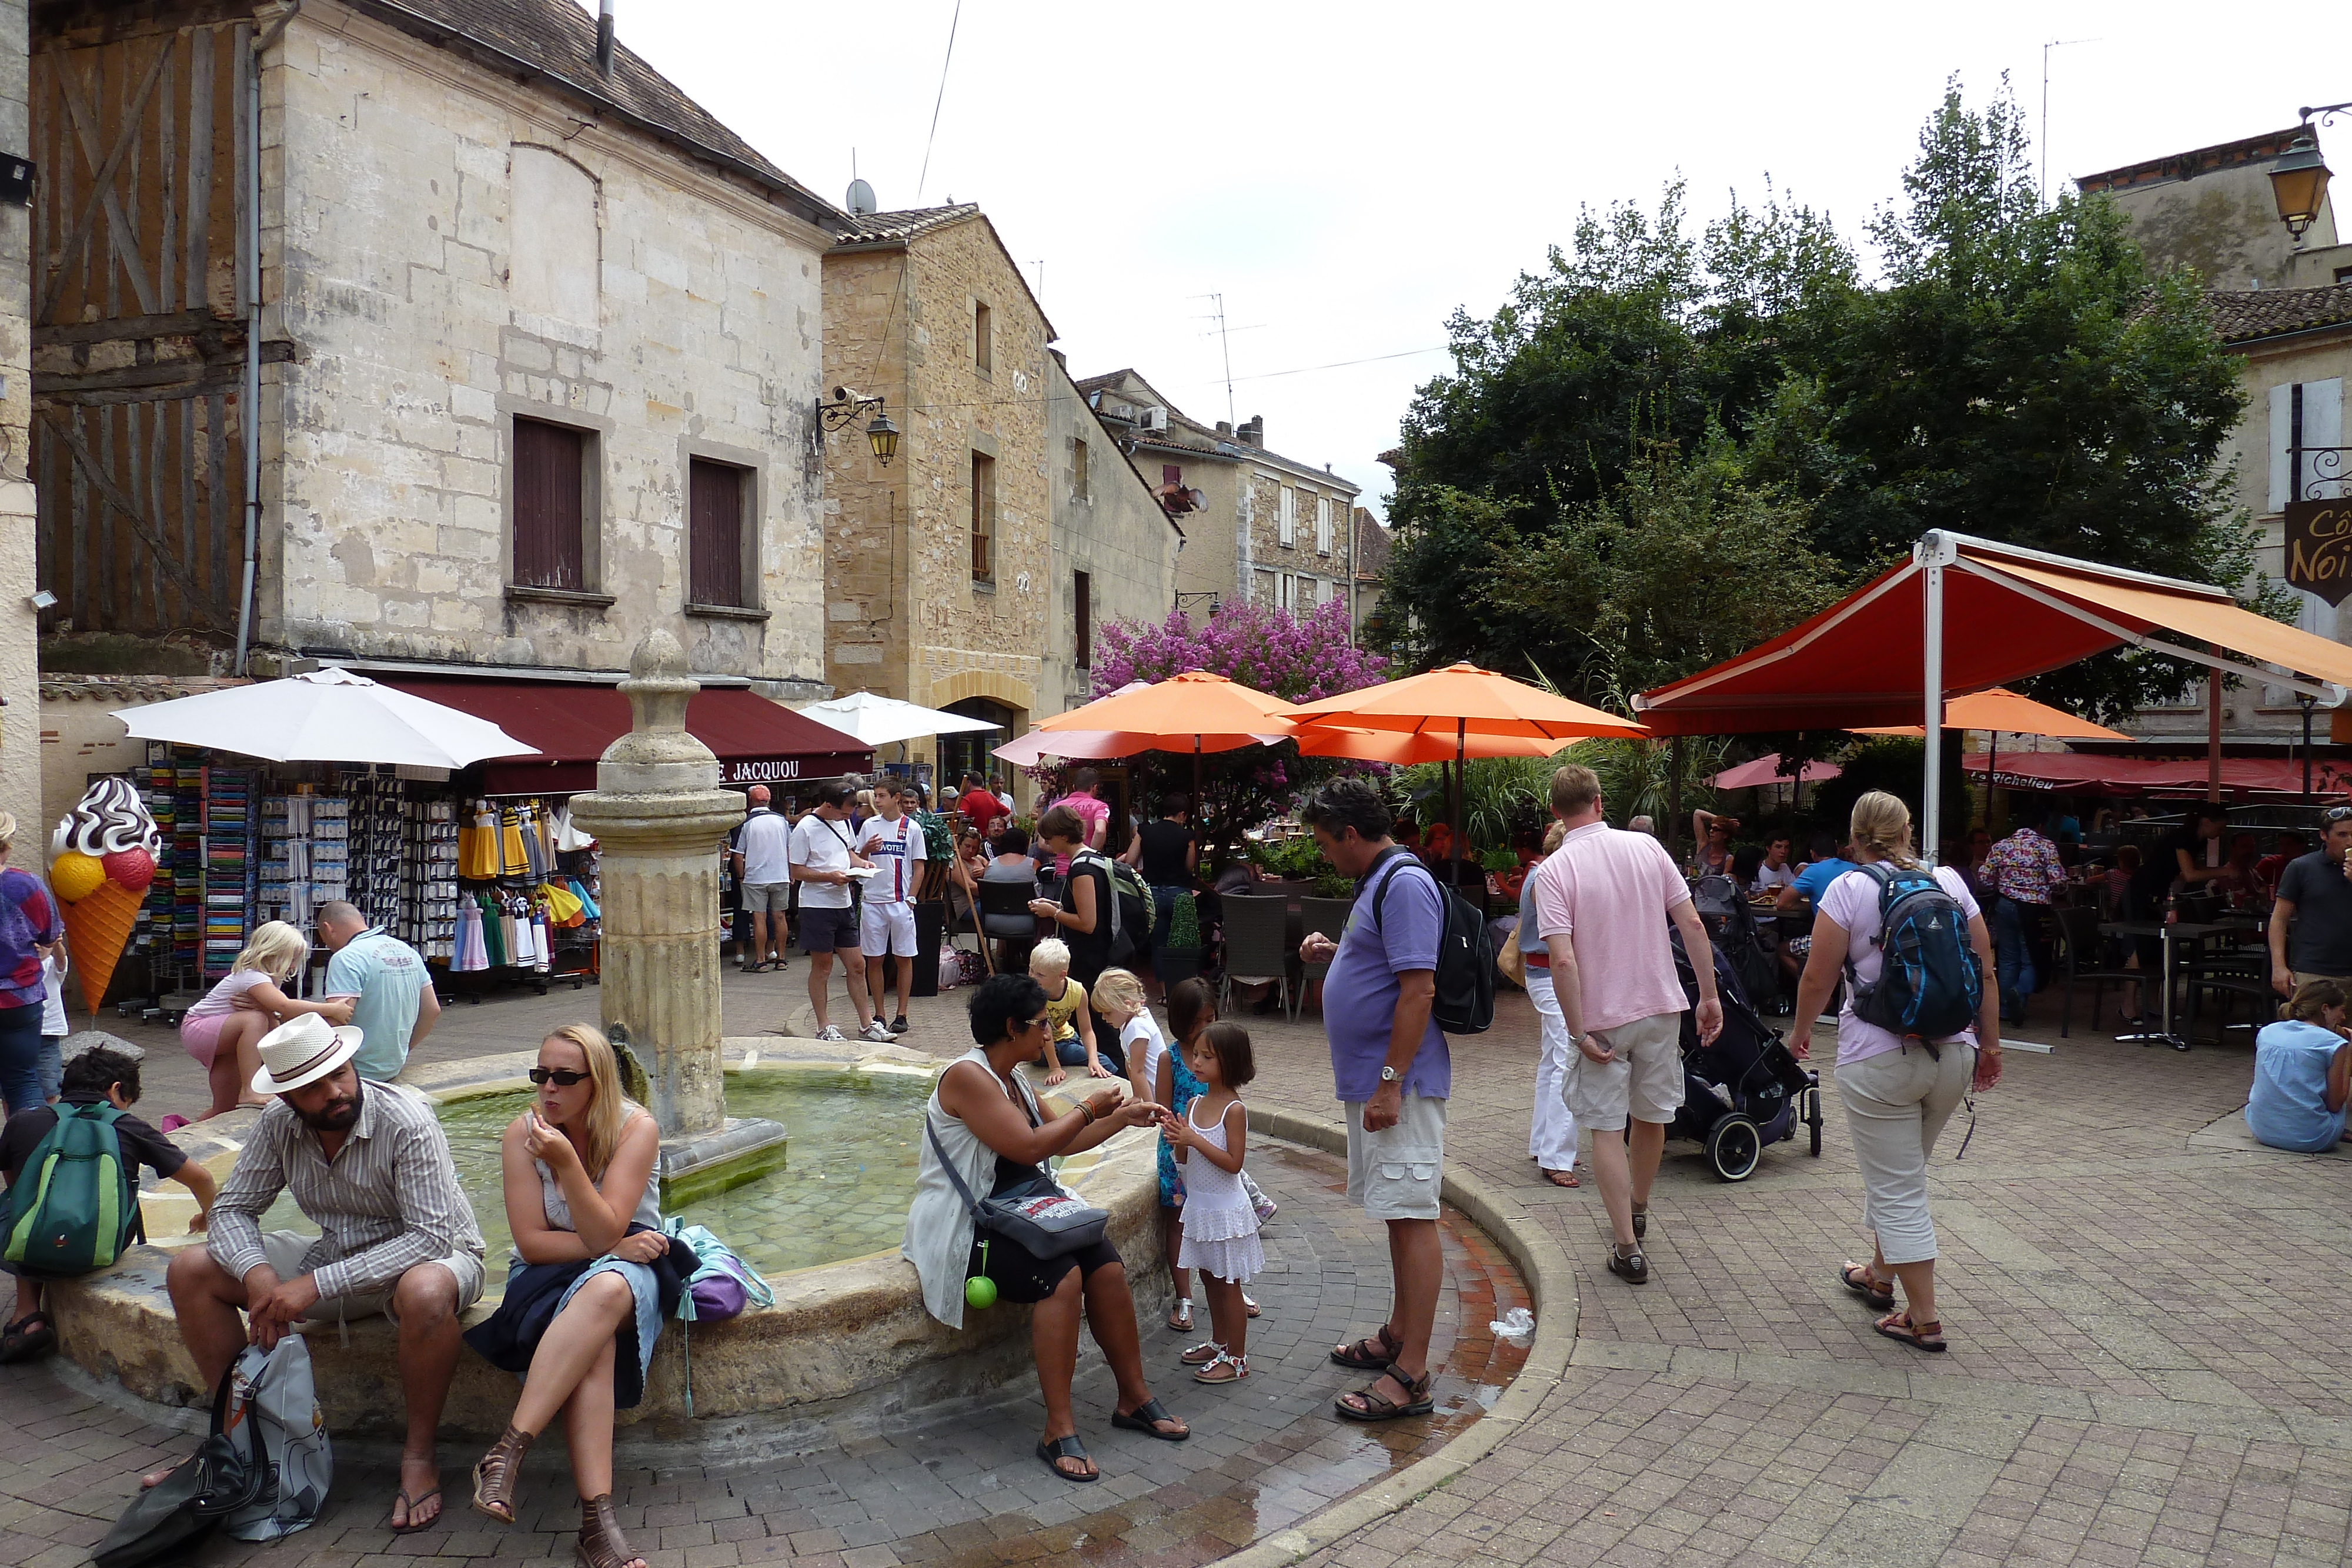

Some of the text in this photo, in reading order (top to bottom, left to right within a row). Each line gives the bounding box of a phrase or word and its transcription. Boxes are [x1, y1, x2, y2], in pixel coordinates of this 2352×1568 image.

[2309, 510, 2352, 537] Cô
[2290, 534, 2352, 581] Noi
[733, 761, 799, 781] JACQUOU
[1993, 773, 2054, 790] Richelieu
[878, 844, 905, 852] OVOTEL
